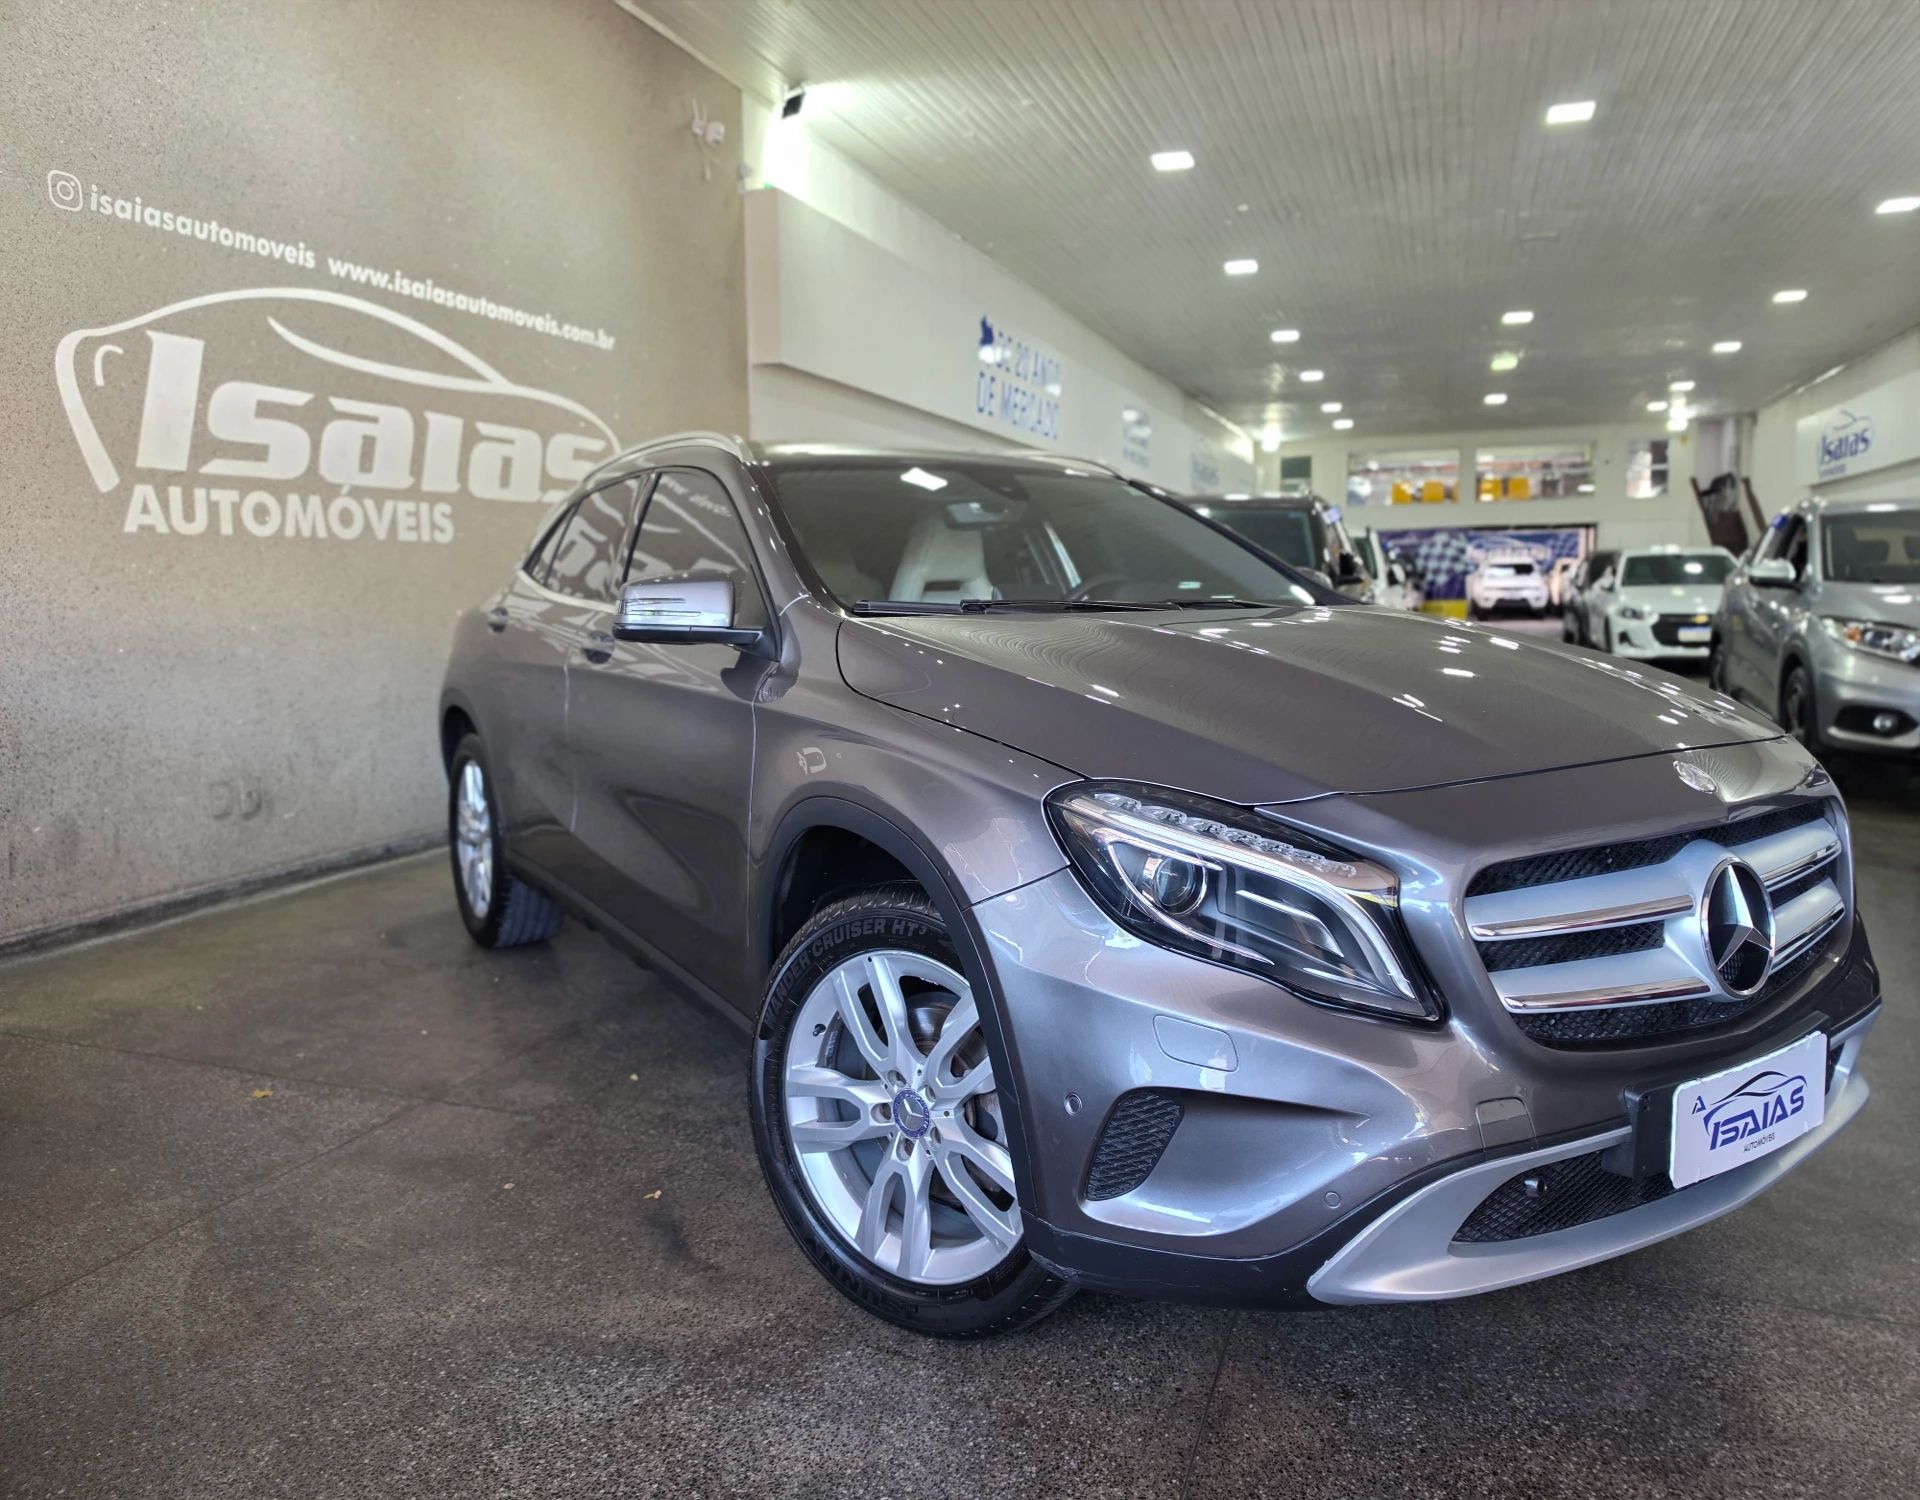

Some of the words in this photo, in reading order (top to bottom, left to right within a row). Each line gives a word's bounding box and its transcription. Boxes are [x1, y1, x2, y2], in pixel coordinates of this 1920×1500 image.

[90, 184, 316, 269] isaiasautomoveis
[328, 257, 615, 351] www.isaiasautomoveis.com.br
[124, 484, 455, 543] AUTOMÓVEIS
[812, 918, 886, 957] CRUISER
[1709, 1085, 1805, 1151] ISAIAS
